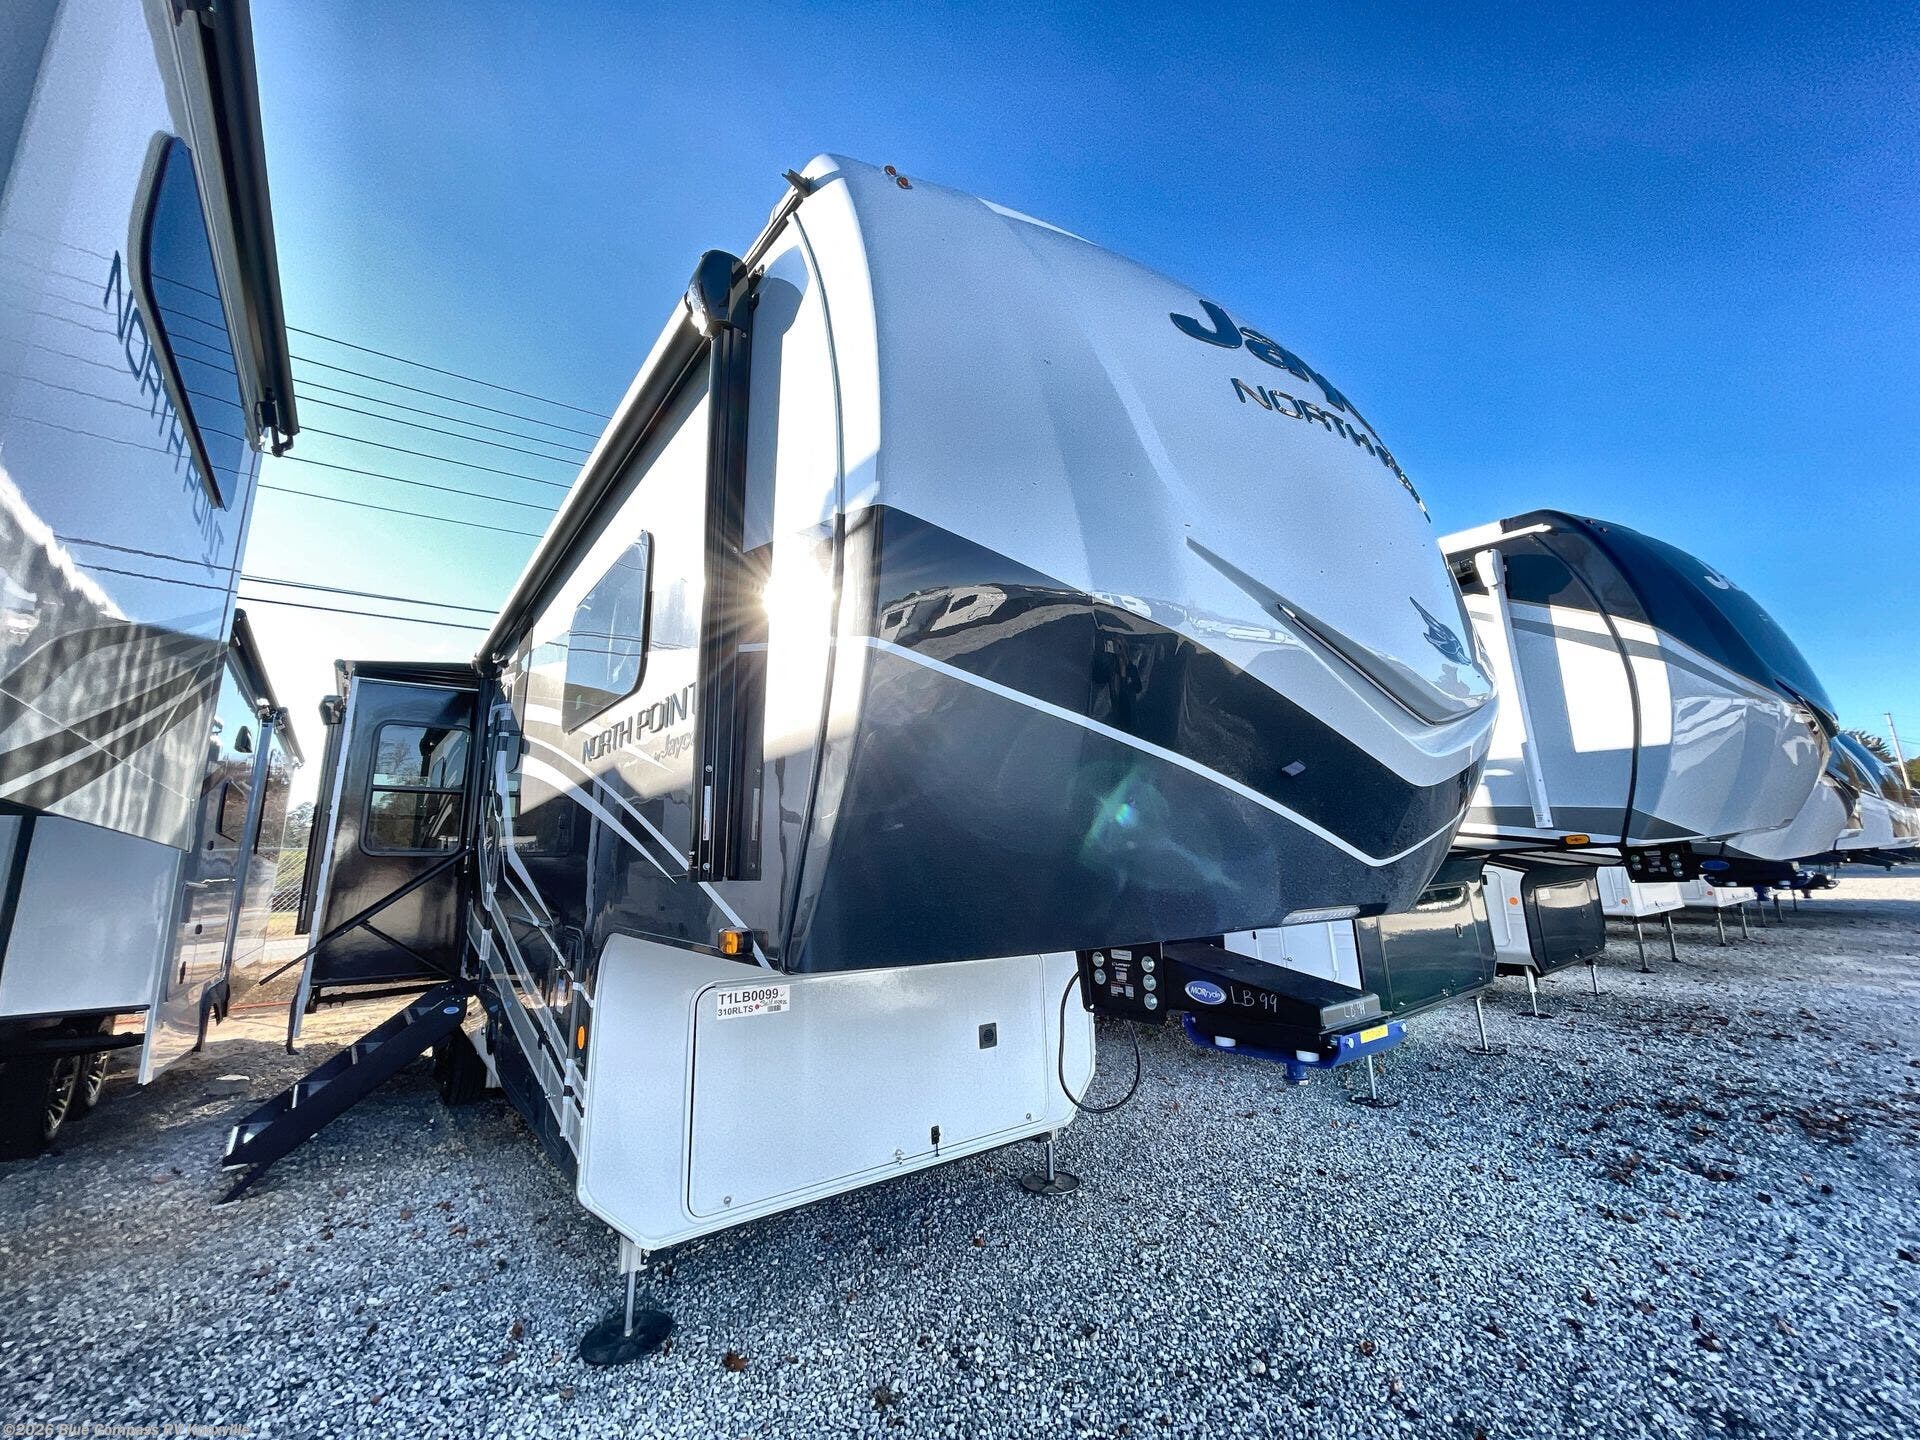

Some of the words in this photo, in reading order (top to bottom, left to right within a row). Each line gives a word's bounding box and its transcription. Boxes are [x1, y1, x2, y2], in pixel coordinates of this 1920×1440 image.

[103, 249, 185, 474] NORTH
[183, 456, 225, 564] POINT
[1230, 377, 1376, 457] NORTH
[583, 716, 633, 764] NORTH
[635, 681, 697, 741] POINT
[717, 1006, 754, 1016] 310RLTS
[718, 988, 779, 1005] T1LB0099
